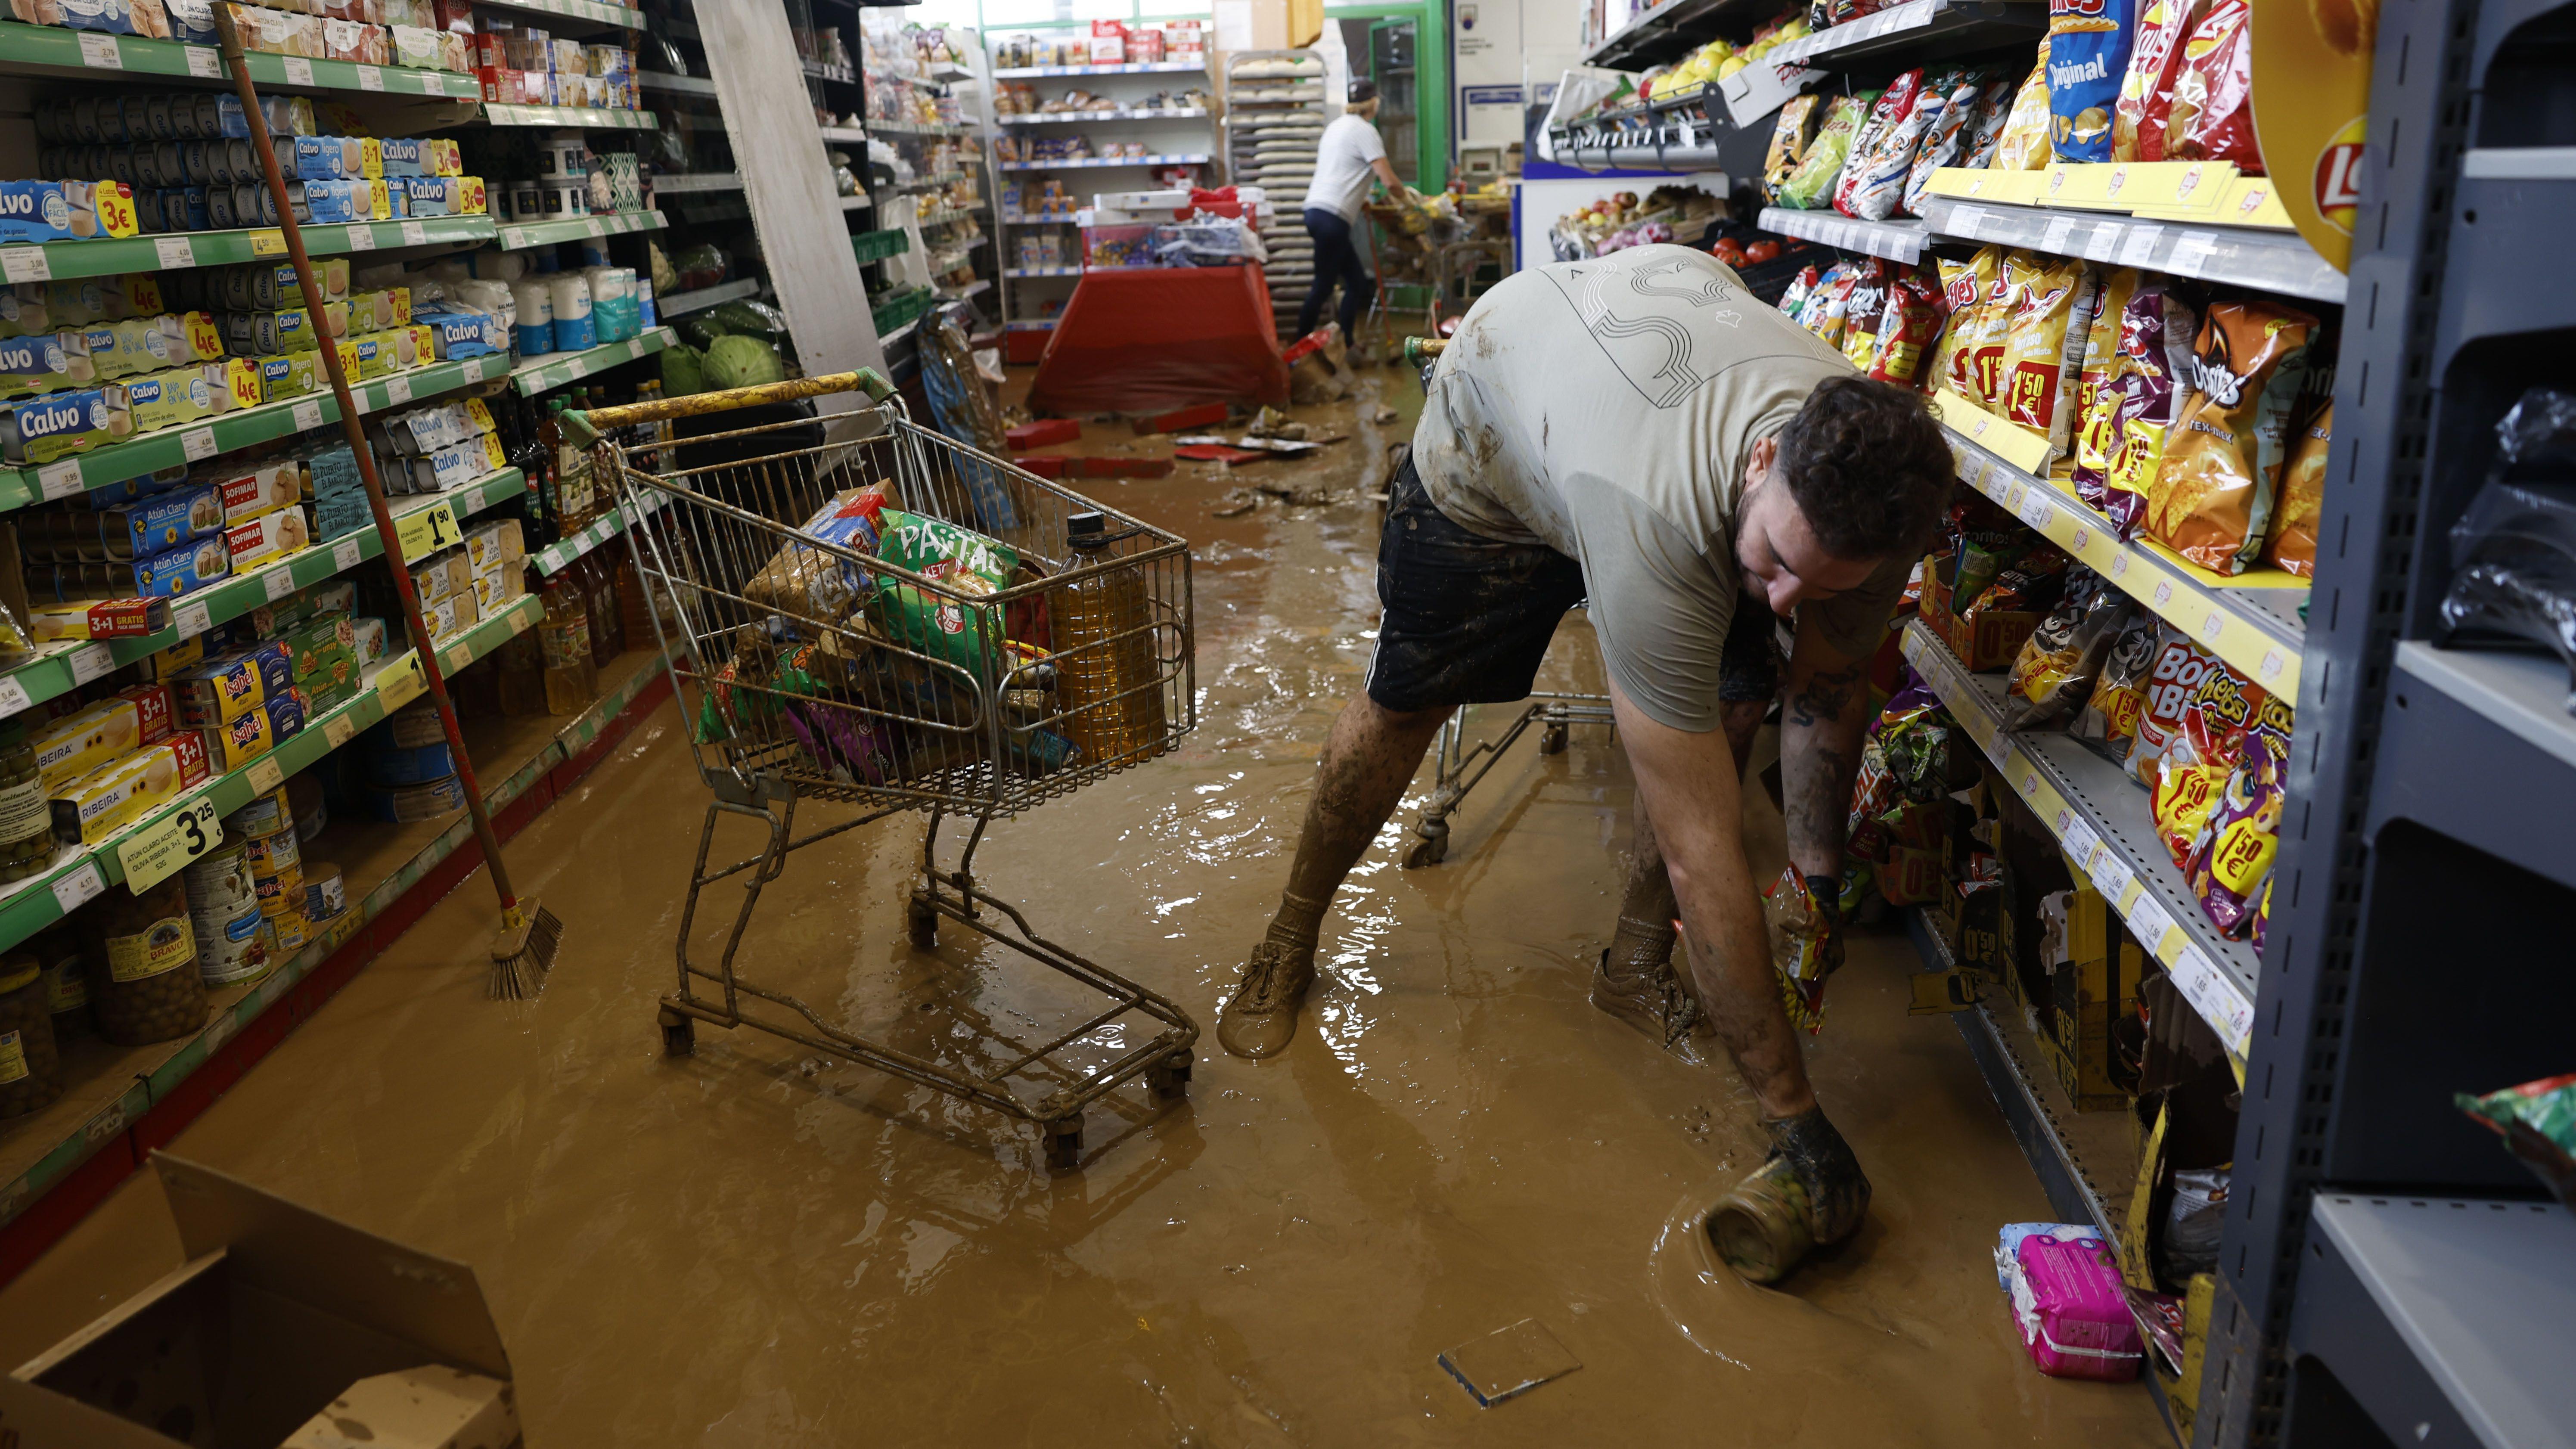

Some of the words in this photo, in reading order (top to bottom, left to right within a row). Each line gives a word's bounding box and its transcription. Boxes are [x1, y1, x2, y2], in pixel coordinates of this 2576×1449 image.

[2048, 52, 2108, 90] Original
[299, 143, 319, 154] Calvo
[321, 143, 339, 155] ligero
[363, 145, 378, 163] 3+1
[381, 141, 416, 160] Calvo
[309, 187, 329, 198] Calvo
[331, 186, 349, 199] ligero
[388, 180, 404, 190] Calvo
[410, 181, 443, 199] Calvo
[372, 186, 386, 203] 3+1
[103, 200, 130, 231] 3€
[134, 284, 157, 311] 4€
[355, 301, 372, 313] ligero
[396, 303, 408, 322] 4€
[279, 316, 300, 328] Calvo
[445, 323, 478, 342] Calvo
[195, 328, 218, 354] 4€
[358, 346, 376, 357] Calvo
[419, 341, 431, 360] 4€
[265, 365, 288, 376] Calvo
[292, 359, 311, 373] ligero
[340, 352, 357, 372] 3+1
[131, 385, 159, 399] Calvo
[237, 375, 258, 401] 4€
[21, 407, 79, 437] Calvo
[410, 416, 443, 436] Calvo
[320, 462, 341, 477] PUERTO
[432, 453, 460, 473] Calvo
[64, 473, 77, 483] 3,95
[329, 475, 343, 487] BARCO
[226, 482, 256, 499] SOFIMAR
[148, 507, 166, 521] Atún
[167, 502, 186, 515] Claro
[229, 507, 242, 518] Atún
[327, 504, 348, 520] PUERTO
[335, 517, 350, 529] BARCO
[231, 527, 261, 546] SOFIMAR
[471, 543, 484, 555] ALBO
[489, 545, 499, 555] ATÚN
[154, 557, 172, 571] Atún
[173, 551, 191, 564] Claro
[235, 554, 249, 565] Atún
[487, 552, 500, 563] CLARO
[436, 585, 449, 596] CLARO
[438, 578, 447, 588] ATÚN
[478, 584, 490, 595] ALBO
[493, 584, 503, 594] ATÚN
[493, 591, 504, 602] CLARO
[91, 616, 113, 631] 3+1
[116, 615, 144, 625] GRATIS
[426, 615, 439, 627] ALBO
[442, 622, 455, 633] CLARO
[444, 616, 454, 625] ATÚN
[223, 668, 256, 698] Isabel
[141, 691, 167, 721] 3+1
[144, 714, 168, 733] GRATIS
[229, 714, 264, 746] Isabel
[178, 735, 203, 766] 3+1
[184, 758, 205, 778] GRATIS
[82, 791, 120, 819] RIBEIRA
[217, 828, 222, 837] €
[127, 848, 143, 863] ATÚN
[143, 839, 160, 855] CLARO
[160, 828, 179, 846] ACEITE
[2080, 841, 2089, 855] 1,65
[133, 857, 149, 872] OLIVA
[149, 846, 170, 863] RIBEIRA
[171, 838, 181, 850] 3+1
[155, 859, 167, 871] 52G
[2112, 875, 2122, 889] 1,65
[2149, 924, 2160, 940] 1,50
[149, 941, 183, 960] BRAVO
